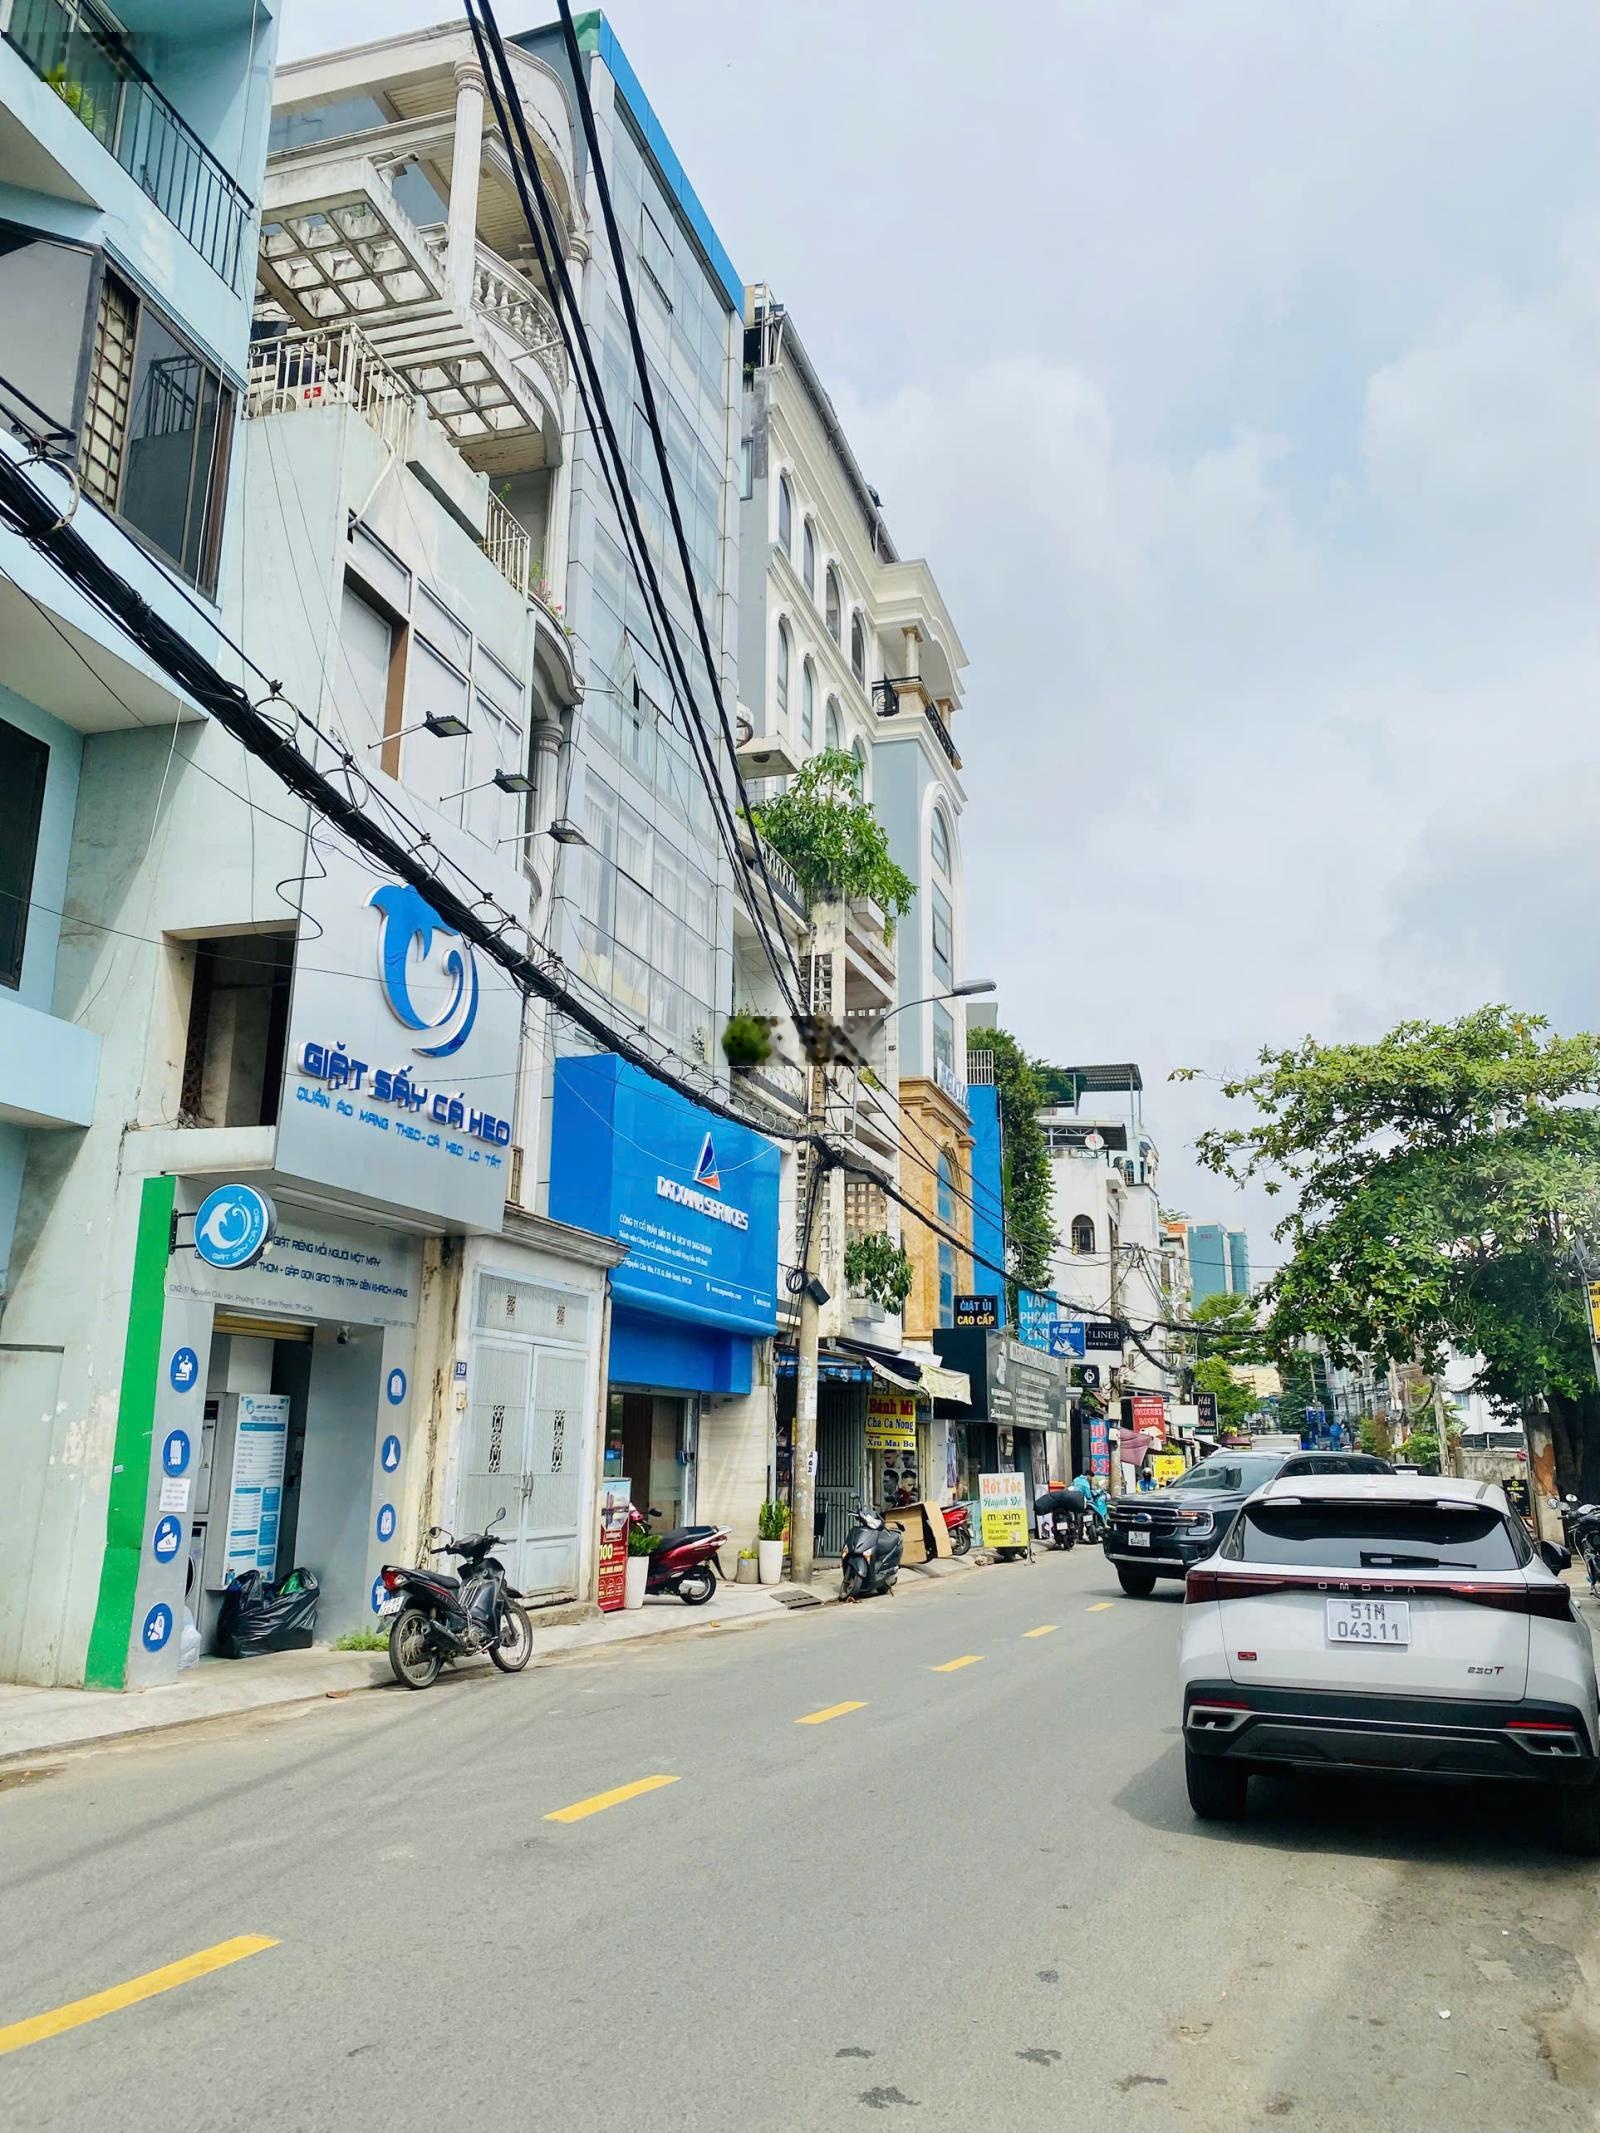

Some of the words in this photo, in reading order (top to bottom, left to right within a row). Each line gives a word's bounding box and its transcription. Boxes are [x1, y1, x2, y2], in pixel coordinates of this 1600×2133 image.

[300, 1041, 368, 1090] GIẶT
[370, 1065, 428, 1113] SẤY
[429, 1092, 466, 1129] CÁ
[466, 1108, 511, 1147] HEO
[360, 1109, 389, 1130] MANG
[445, 1140, 464, 1157] HEO
[469, 1149, 481, 1162] LO
[346, 1278, 358, 1288] TAY
[959, 1299, 980, 1314] GIẶT
[982, 1298, 992, 1311] ỦI
[957, 1315, 975, 1325] CAO
[976, 1312, 995, 1325] CẤP
[457, 1363, 466, 1374] 19
[869, 1400, 897, 1415] Bánh
[1350, 1603, 1385, 1621] 51M
[1337, 1620, 1399, 1641] 043.11
